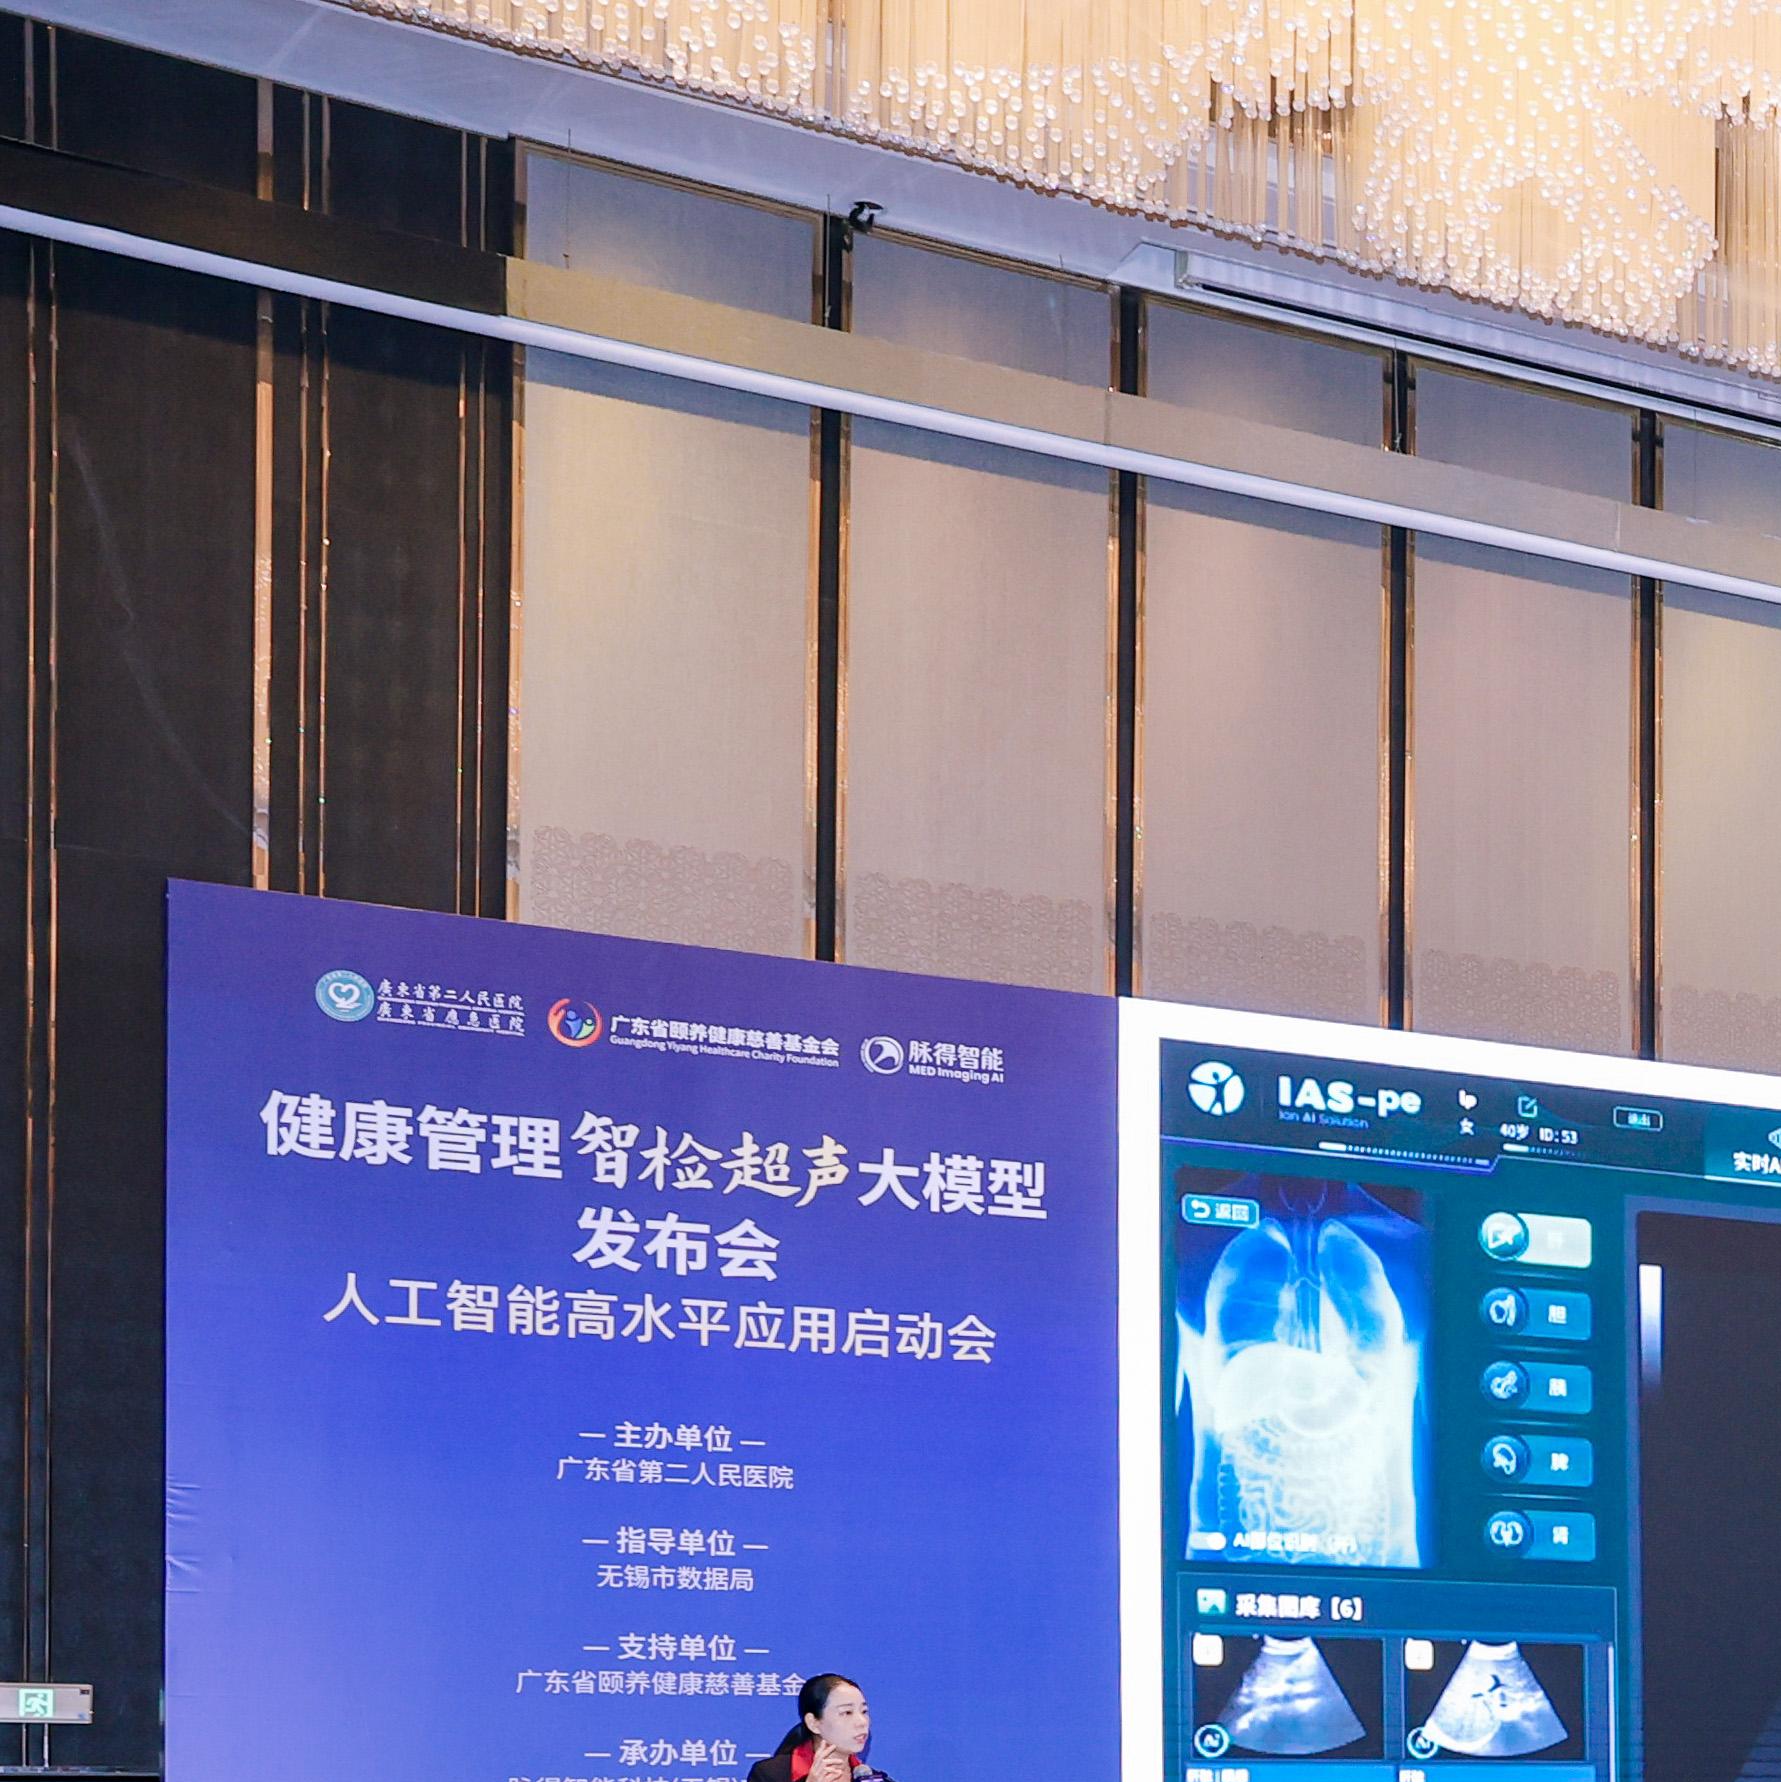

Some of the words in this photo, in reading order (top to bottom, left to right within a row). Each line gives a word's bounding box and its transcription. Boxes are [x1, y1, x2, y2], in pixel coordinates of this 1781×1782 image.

[610, 1015, 840, 1057] 广东省颐养健康慈善基金会
[610, 1035, 666, 1051] Guangdong
[667, 1040, 698, 1056] Yiyang
[700, 1043, 750, 1059] Healthcare
[752, 1048, 785, 1064] Charity
[786, 1052, 839, 1068] Foundation
[909, 1040, 1004, 1072] 脉得智能
[909, 1064, 936, 1077] MED
[938, 1066, 989, 1084] Imaging
[991, 1072, 1004, 1082] AI
[1278, 1075, 1421, 1116] IAS-pe
[260, 1087, 1048, 1220] 健康管理智检超声大模型
[573, 1208, 780, 1282] 发布会
[323, 1271, 997, 1366] 人工智能高水平应用启动会
[614, 1422, 732, 1454] 主办单位
[555, 1456, 795, 1490] 广东省第二人民医院
[616, 1526, 734, 1557] 指导单位
[597, 1563, 754, 1593] 无锡市数据局
[618, 1633, 736, 1663] 支持单位
[516, 1668, 806, 1698] 广东省颐养健康慈善基金
[619, 1739, 737, 1768] 承办单位
